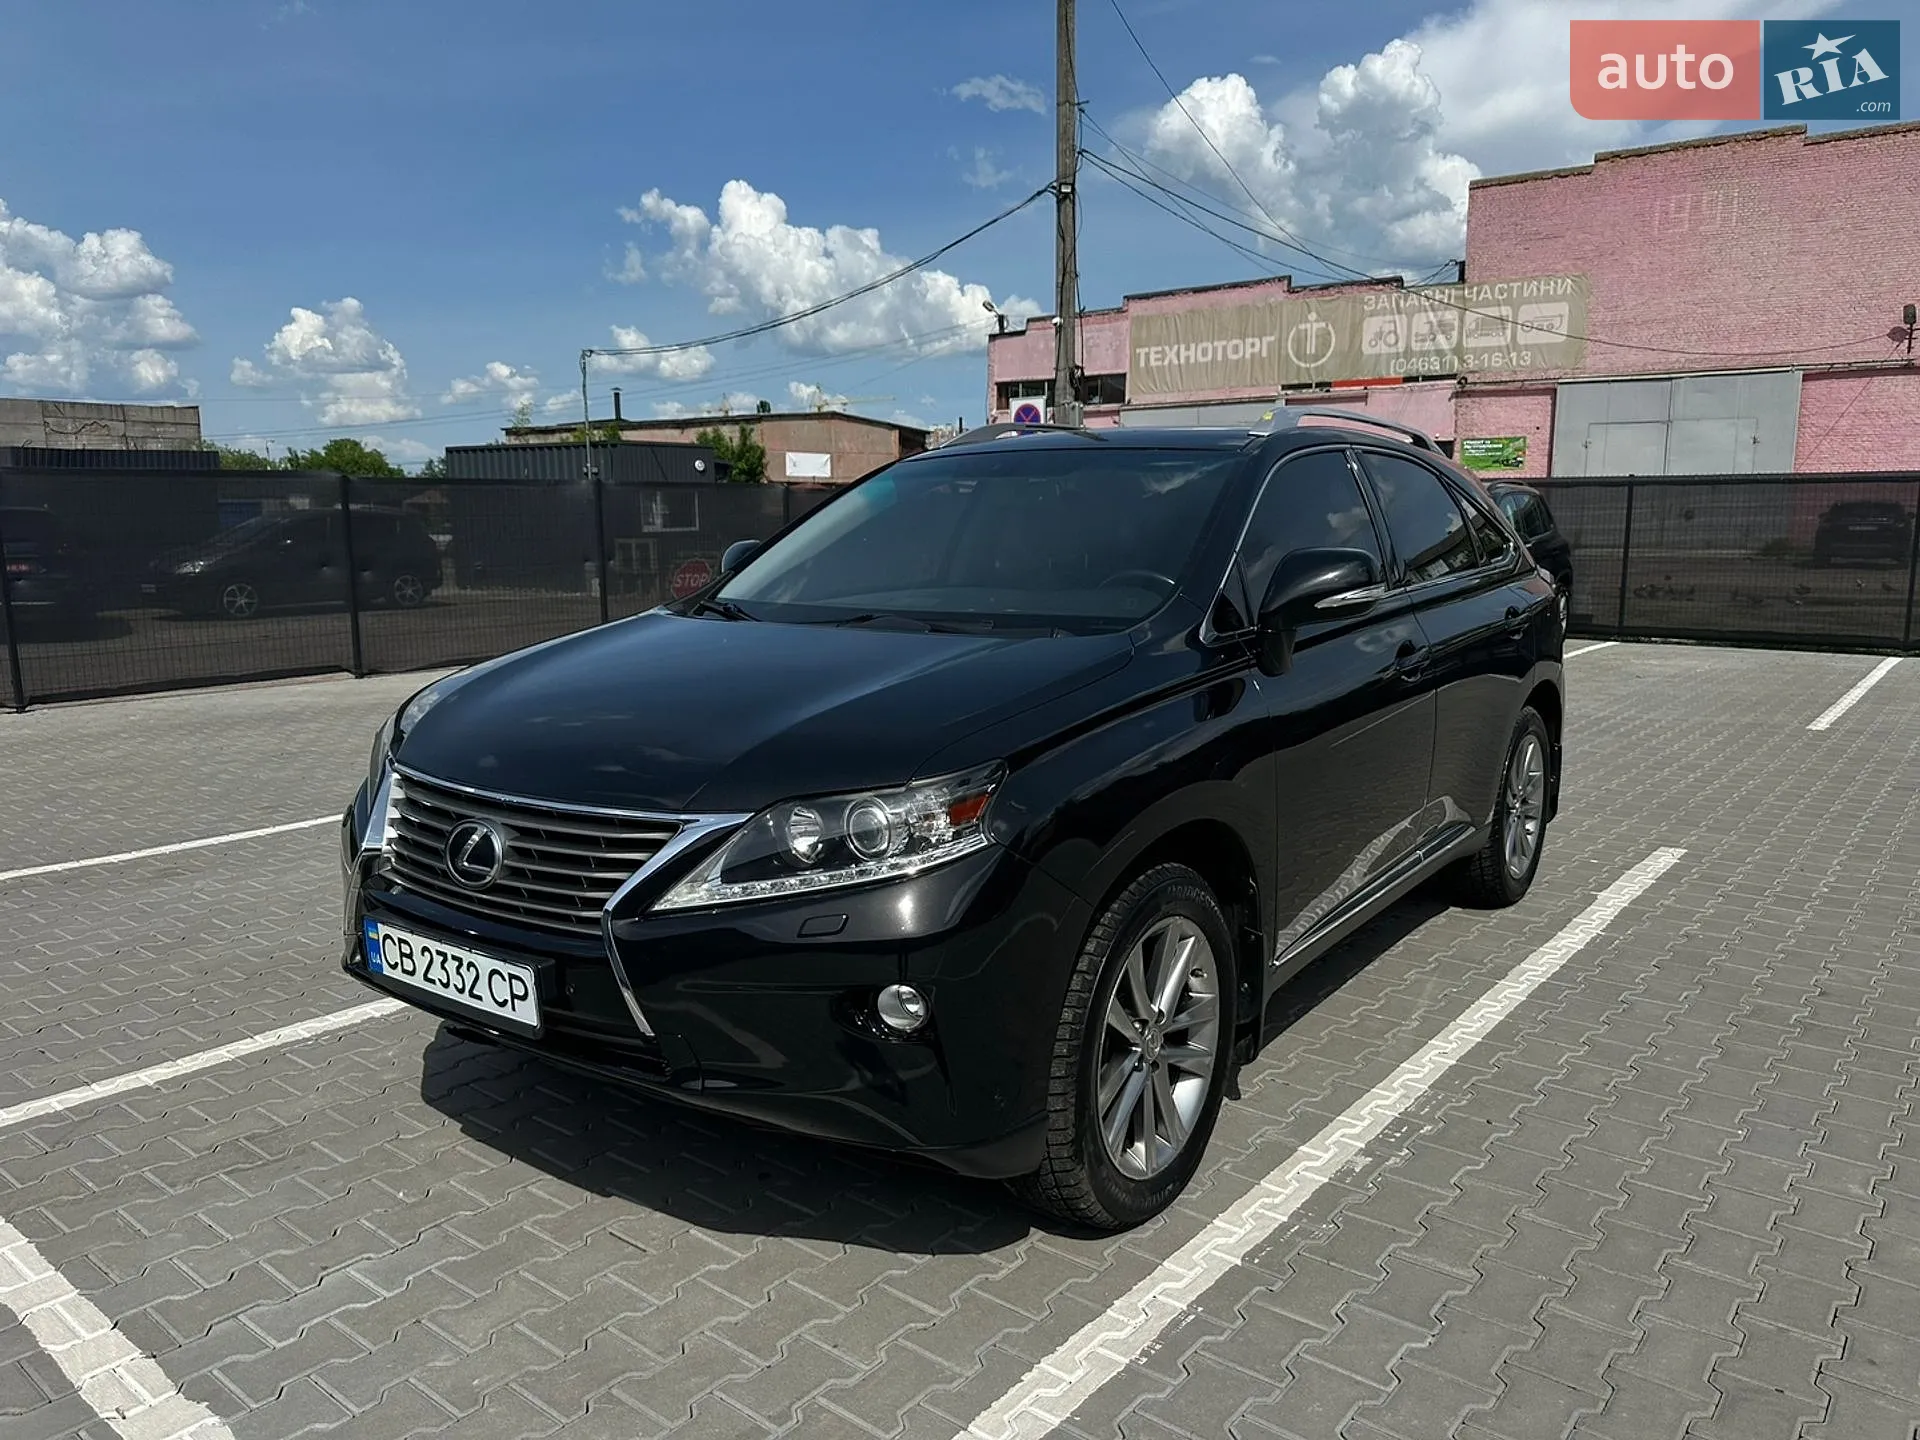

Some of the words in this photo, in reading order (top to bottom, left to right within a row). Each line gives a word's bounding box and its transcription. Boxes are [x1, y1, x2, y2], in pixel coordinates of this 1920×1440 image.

[1363, 288, 1455, 312] ЗАПАСНІ
[1465, 278, 1573, 302] ЧАСТИНИ
[1135, 335, 1276, 368] ТЕХНОТОРГ
[675, 572, 709, 588] STOP
[370, 951, 381, 964] UA
